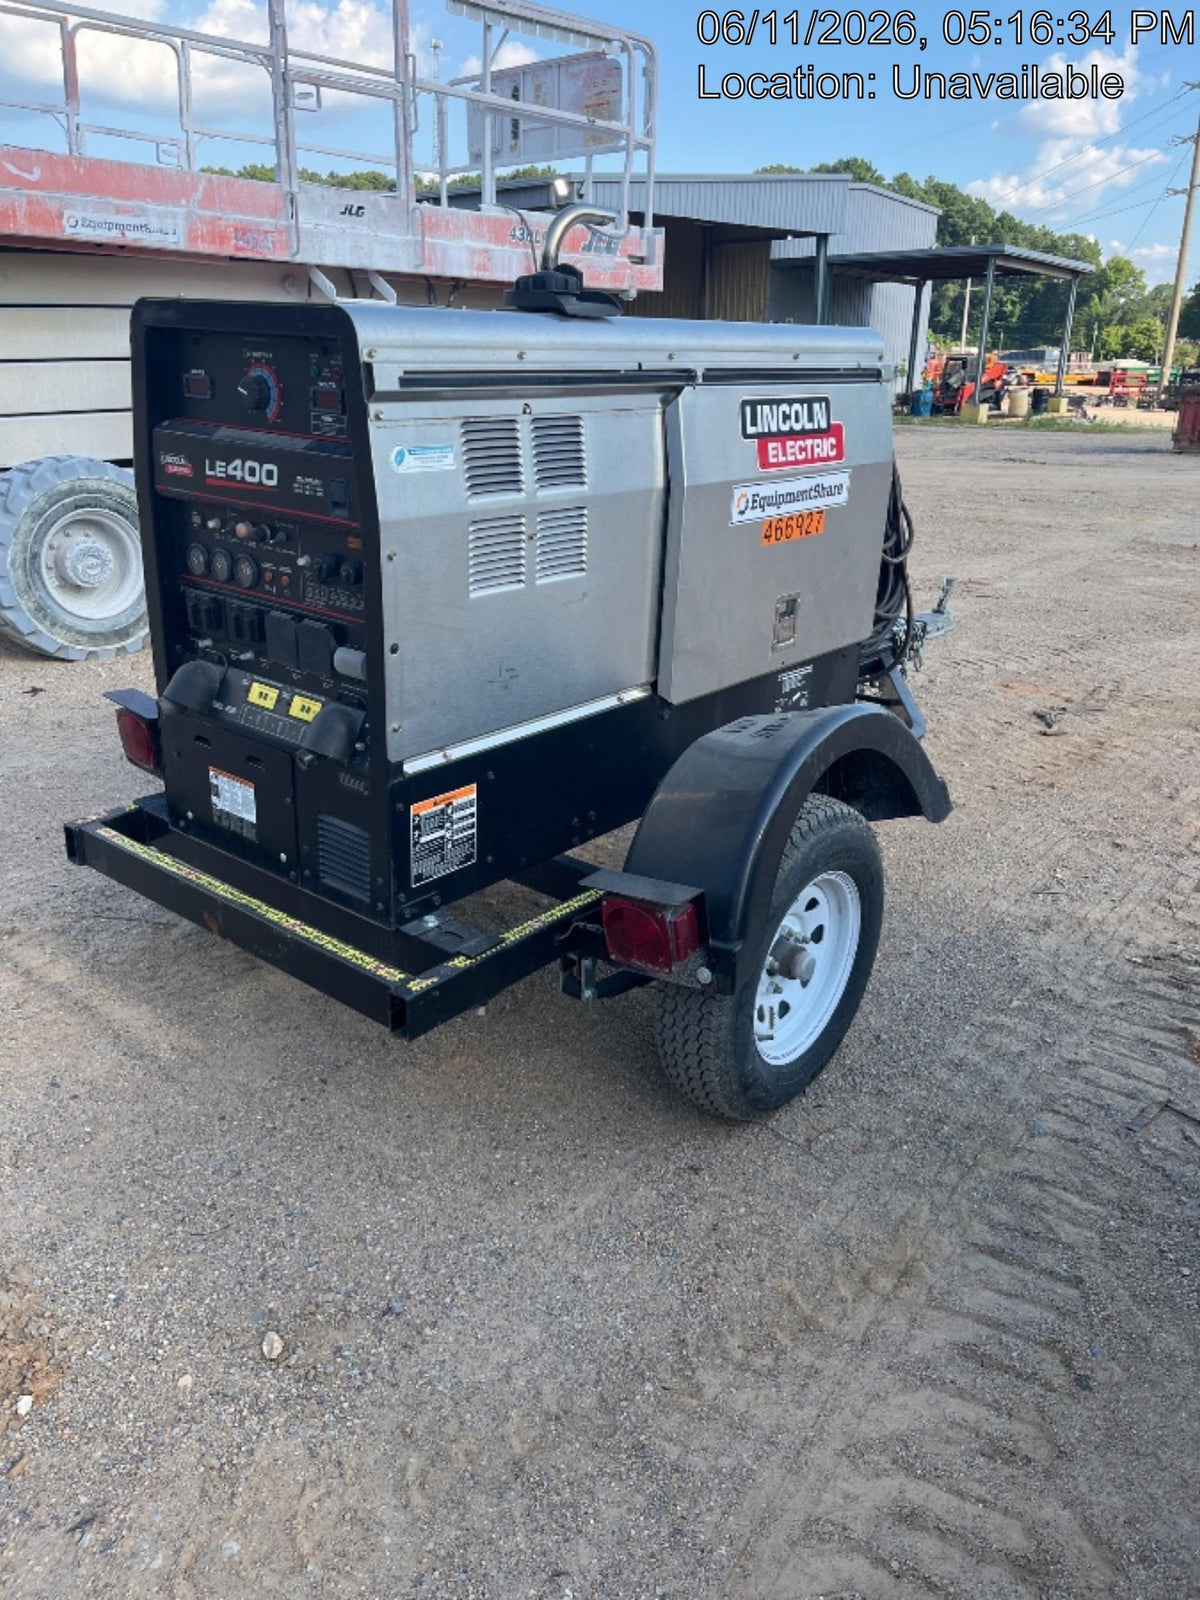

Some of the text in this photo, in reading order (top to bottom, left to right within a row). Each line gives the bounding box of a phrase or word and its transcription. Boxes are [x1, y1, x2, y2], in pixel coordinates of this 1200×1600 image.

[339, 203, 365, 218] JLG
[745, 401, 827, 434] LINCOLN
[767, 437, 837, 463] ELECTRIC
[205, 458, 279, 487] LE400
[750, 482, 844, 512] EquipmentShare
